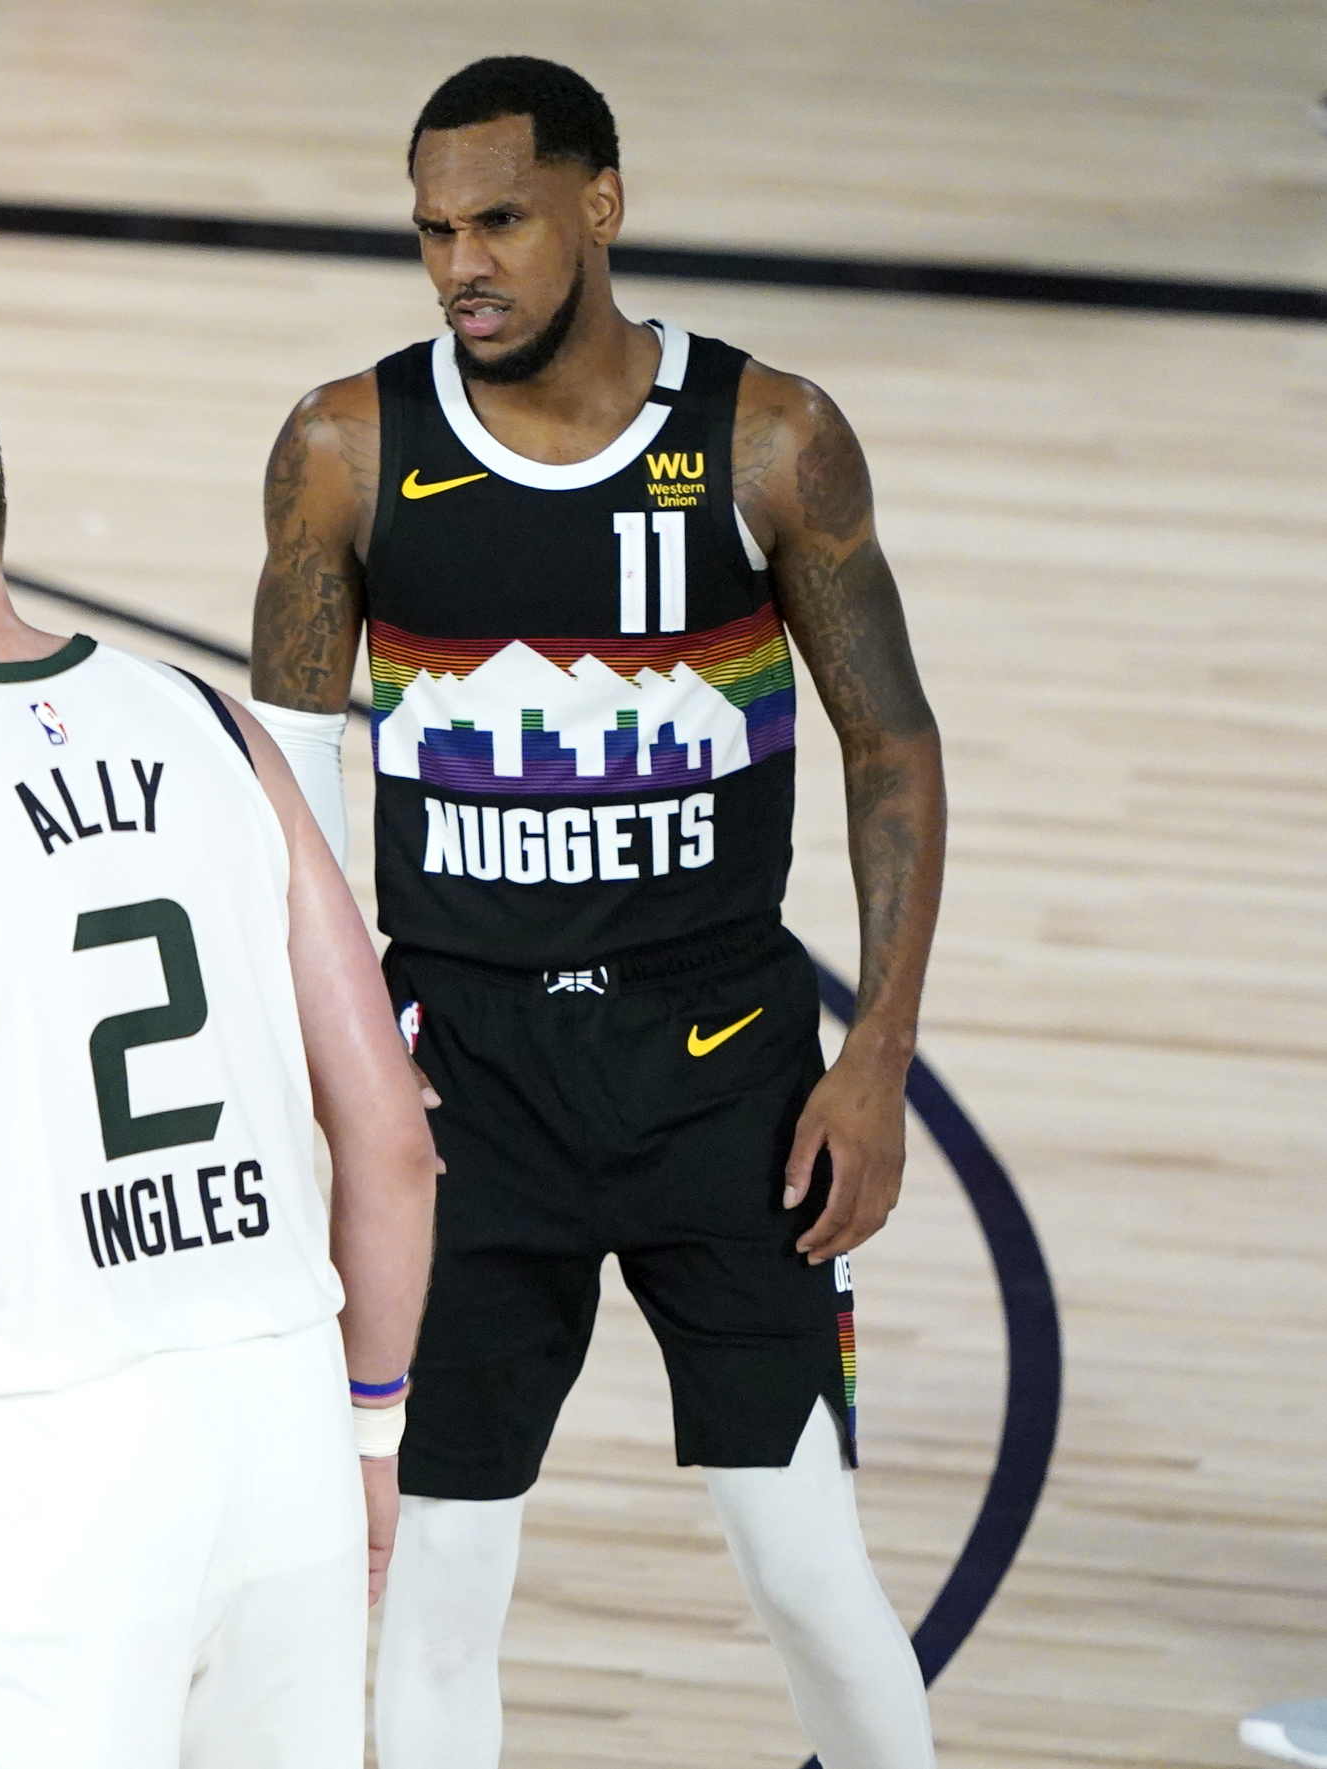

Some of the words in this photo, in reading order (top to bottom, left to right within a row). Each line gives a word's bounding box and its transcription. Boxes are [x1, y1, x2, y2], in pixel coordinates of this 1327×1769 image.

[646, 452, 704, 480] WU
[647, 483, 705, 496] Western
[657, 494, 697, 507] Union
[613, 511, 686, 633] 11
[14, 758, 164, 856] ALLY
[423, 792, 715, 884] NUGGETS
[73, 898, 225, 1162] 2
[80, 1160, 270, 1269] INGLES
